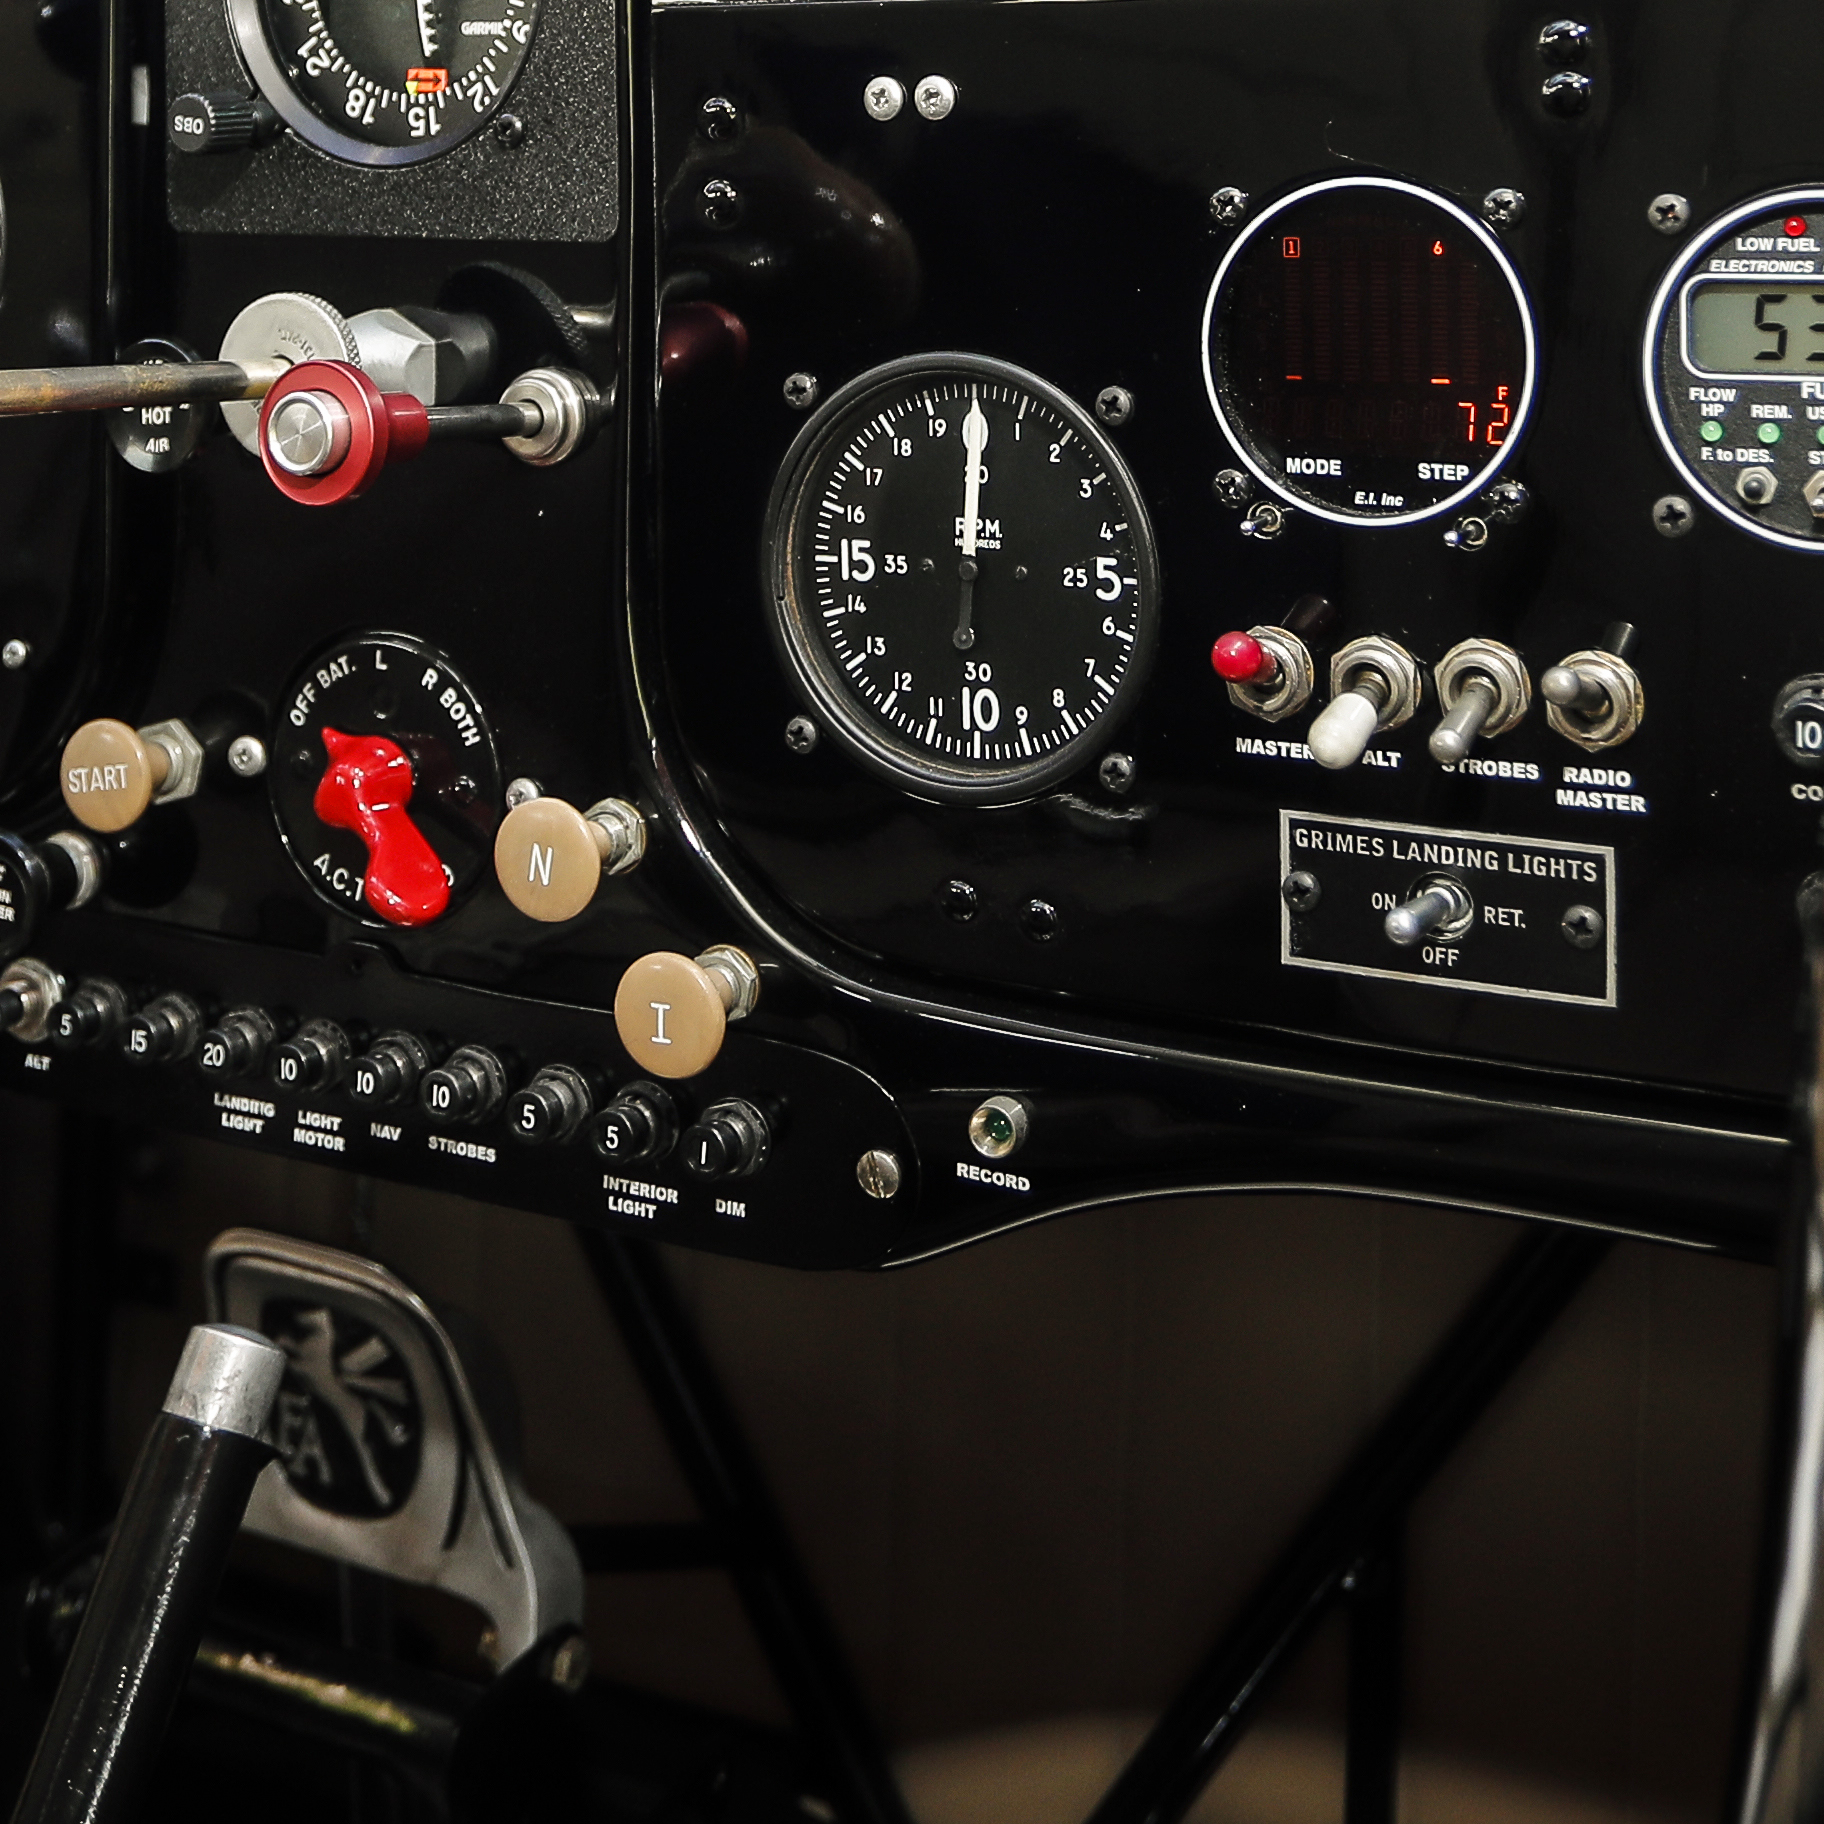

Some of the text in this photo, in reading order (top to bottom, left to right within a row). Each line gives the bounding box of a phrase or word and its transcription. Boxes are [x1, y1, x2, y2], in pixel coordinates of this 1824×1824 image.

[174, 118, 204, 134] OBS
[1735, 238, 1821, 252] LOW FUEL
[1709, 260, 1814, 273] ELECTRONICS
[1689, 388, 1736, 402] FLOW
[141, 406, 172, 426] HOT
[1701, 403, 1725, 416] HP
[1750, 405, 1793, 418] REM.
[145, 436, 171, 454] AIR
[1286, 458, 1342, 476] MODE
[1418, 463, 1470, 481] STEP
[841, 538, 875, 582] 15
[1063, 568, 1087, 587] 25
[1096, 557, 1121, 601] 5
[376, 650, 388, 670] L
[964, 662, 992, 683] 30
[290, 655, 357, 726] OFF BAT.
[440, 687, 481, 746] BOTH
[962, 686, 1000, 732] 10
[1362, 750, 1401, 767] ALT
[67, 763, 129, 793] START
[1563, 766, 1632, 787] RADIO
[1556, 789, 1646, 813] MASTER
[1294, 828, 1598, 883] GRIMES LANDING LIGHTS
[1371, 893, 1526, 928] ON RET.
[1422, 946, 1459, 967] OFF
[203, 1044, 225, 1067] 20
[215, 1093, 275, 1117] LANDING
[431, 1085, 450, 1107] 10
[298, 1110, 342, 1132] LIGHT
[293, 1129, 345, 1152] MOTOR
[371, 1123, 402, 1141] NAV
[429, 1136, 497, 1163] STROBES
[956, 1162, 1031, 1192] RECORD
[603, 1175, 679, 1204] INTERIOR
[608, 1197, 657, 1219] LIGHT
[715, 1199, 746, 1217] DIM
